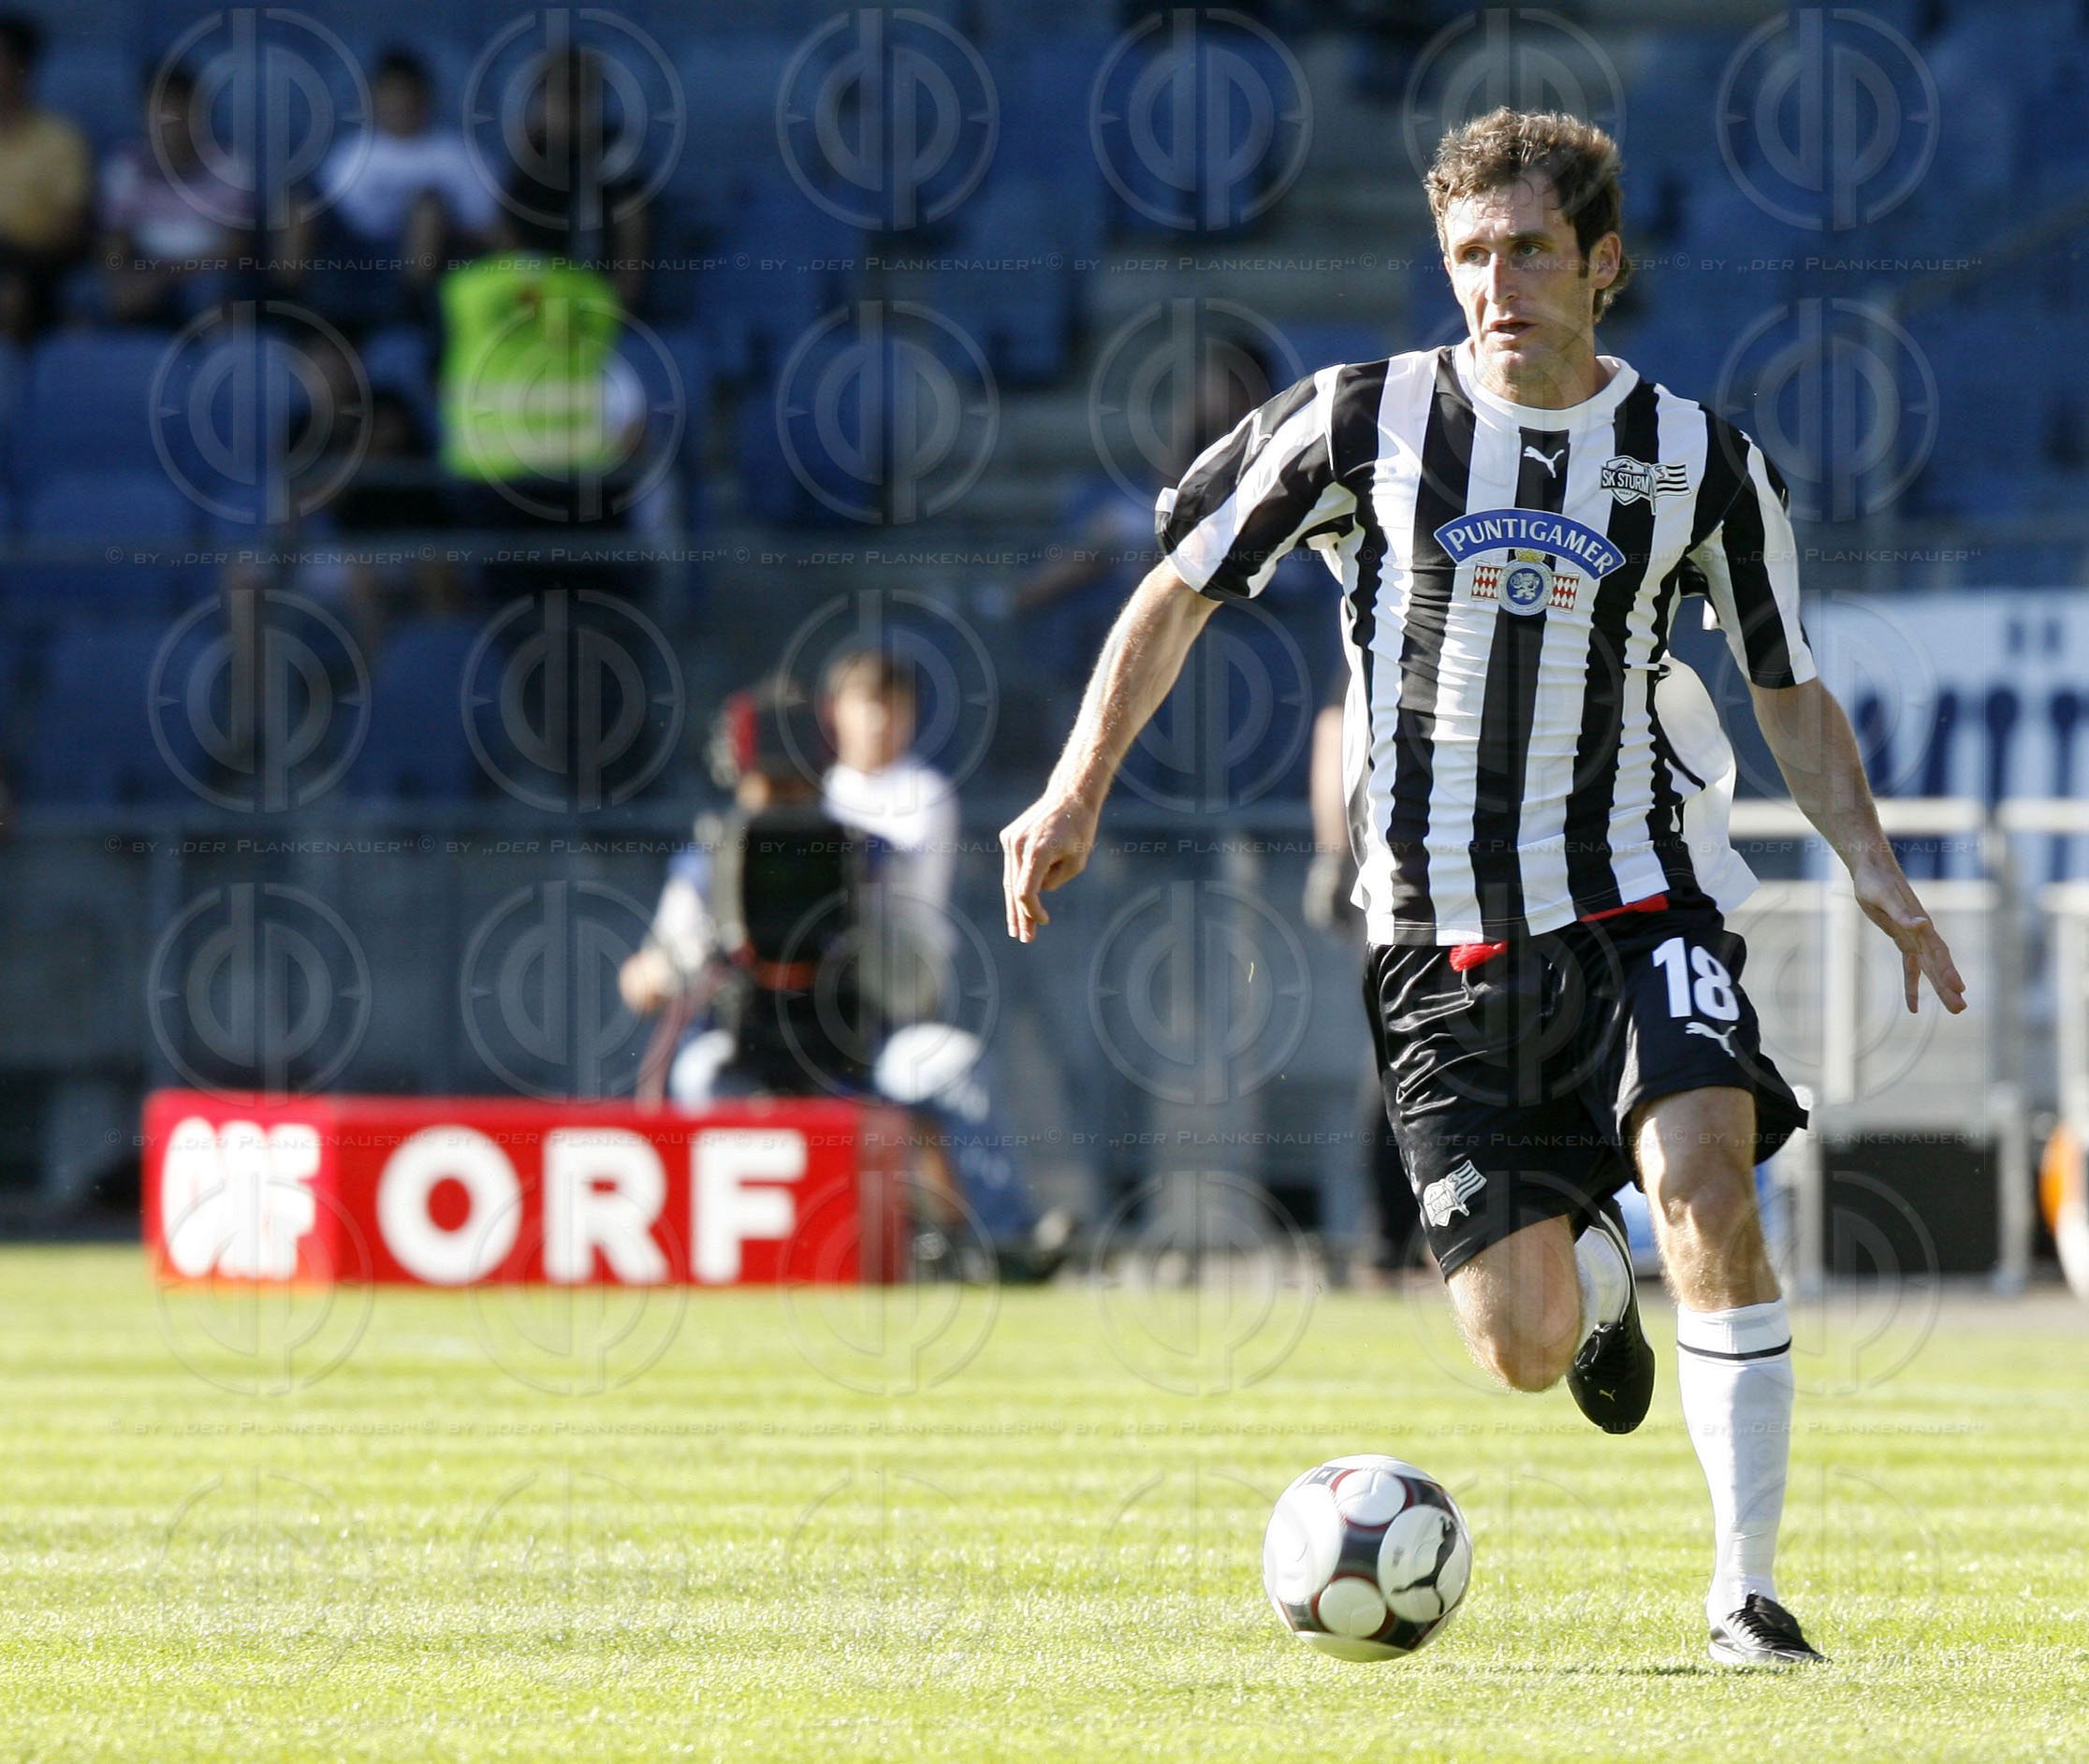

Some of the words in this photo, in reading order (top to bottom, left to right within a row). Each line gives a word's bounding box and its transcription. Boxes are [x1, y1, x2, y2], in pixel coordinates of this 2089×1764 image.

[1446, 518, 1615, 574] PUNTIGAMER
[1652, 937, 1740, 1022] 18
[376, 1125, 810, 1285] ORF
